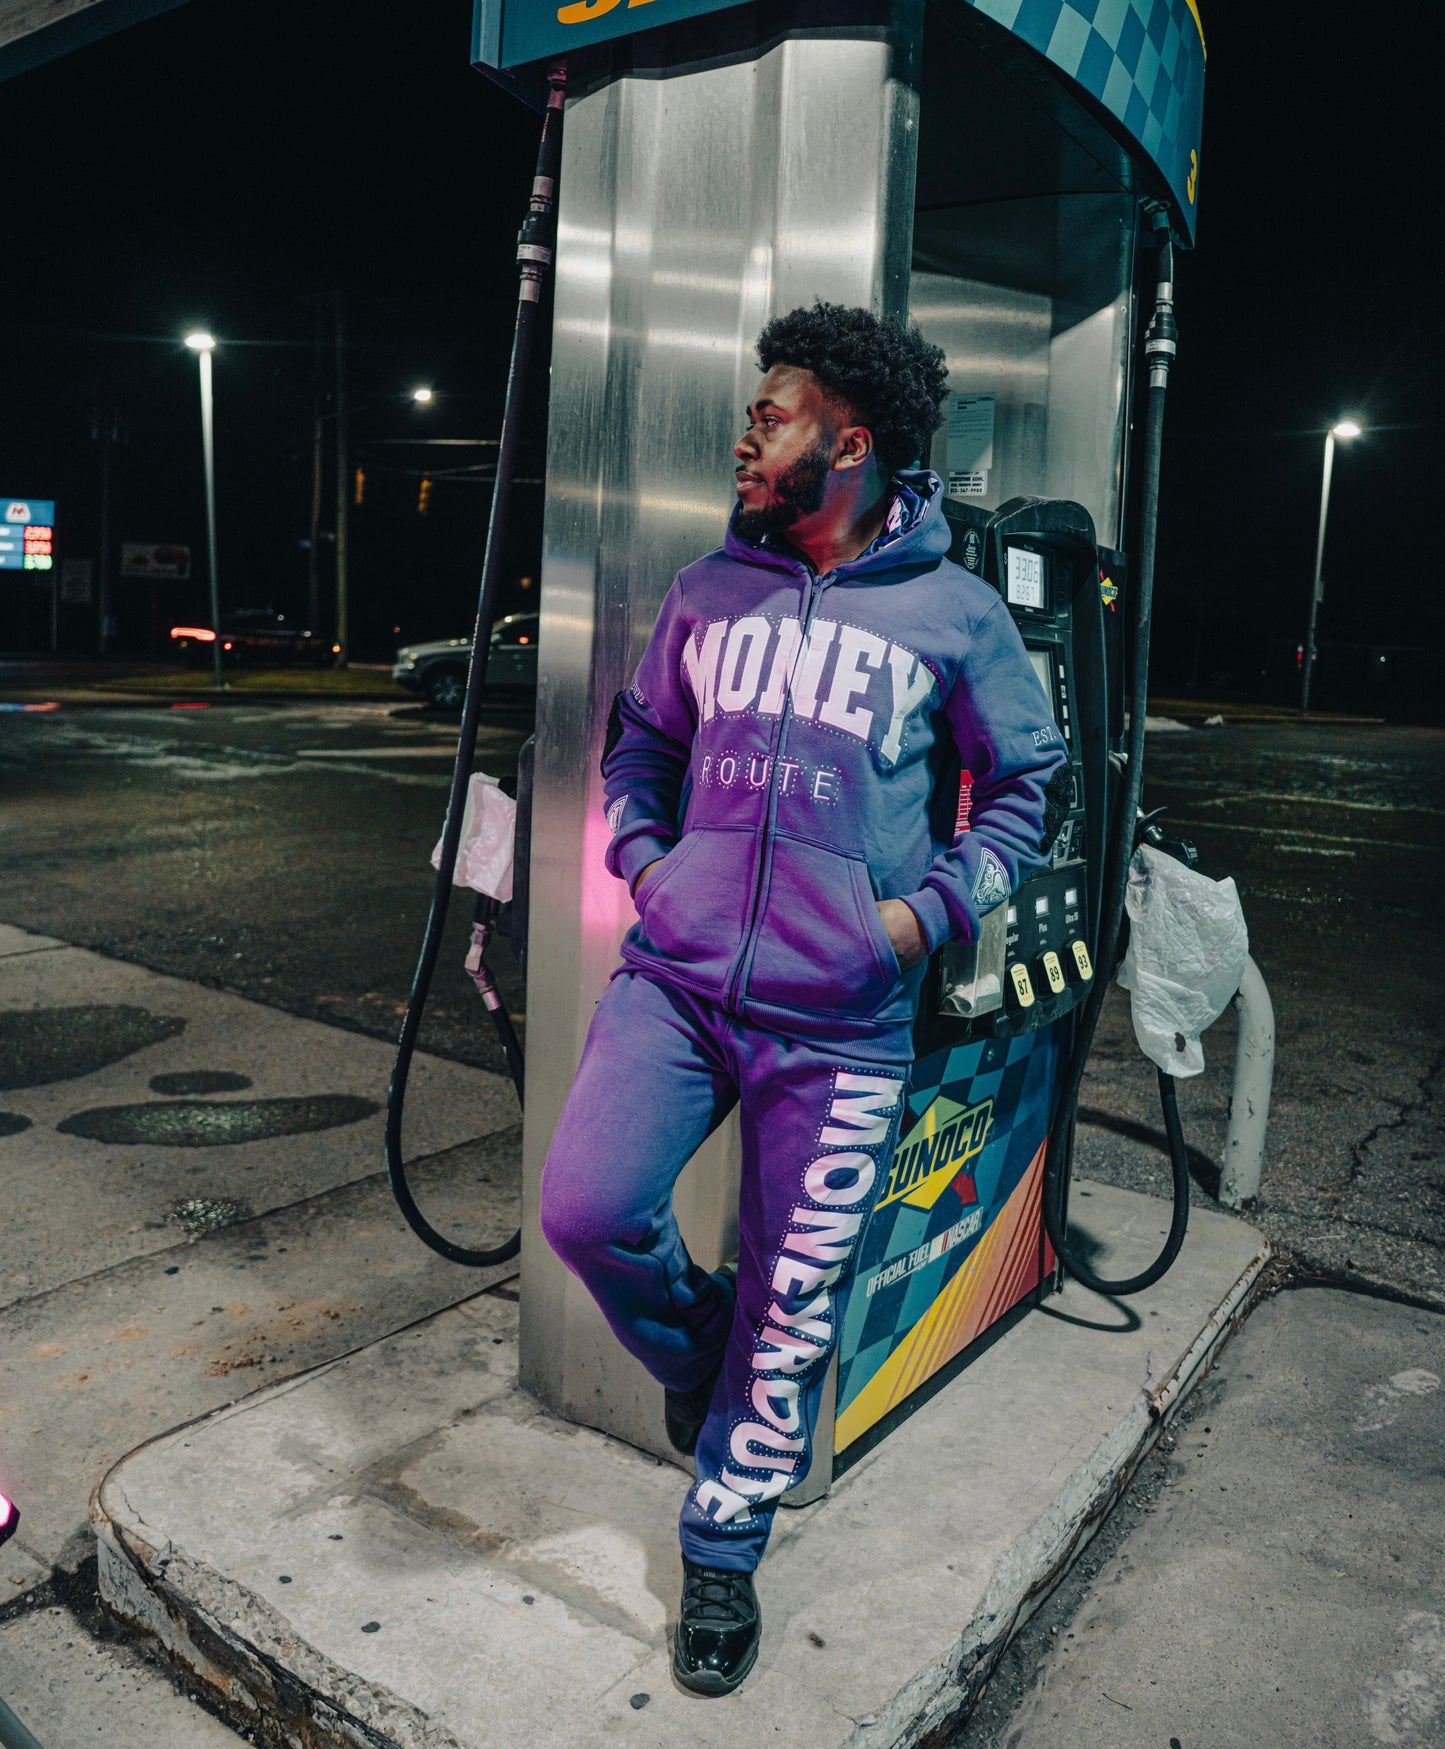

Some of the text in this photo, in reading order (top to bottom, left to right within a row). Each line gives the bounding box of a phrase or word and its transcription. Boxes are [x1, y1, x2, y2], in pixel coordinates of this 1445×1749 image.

[1187, 149, 1198, 205] 3
[681, 616, 936, 766] MONEY
[1031, 726, 1057, 746] EST.
[700, 755, 836, 801] ROUTE
[1049, 966, 1059, 982] 89
[1078, 954, 1089, 970] 93
[1018, 979, 1028, 995] 87
[866, 1257, 907, 1298] OFFICIAL
[908, 1242, 931, 1271] FUEL
[946, 1206, 983, 1249] NASCAR
